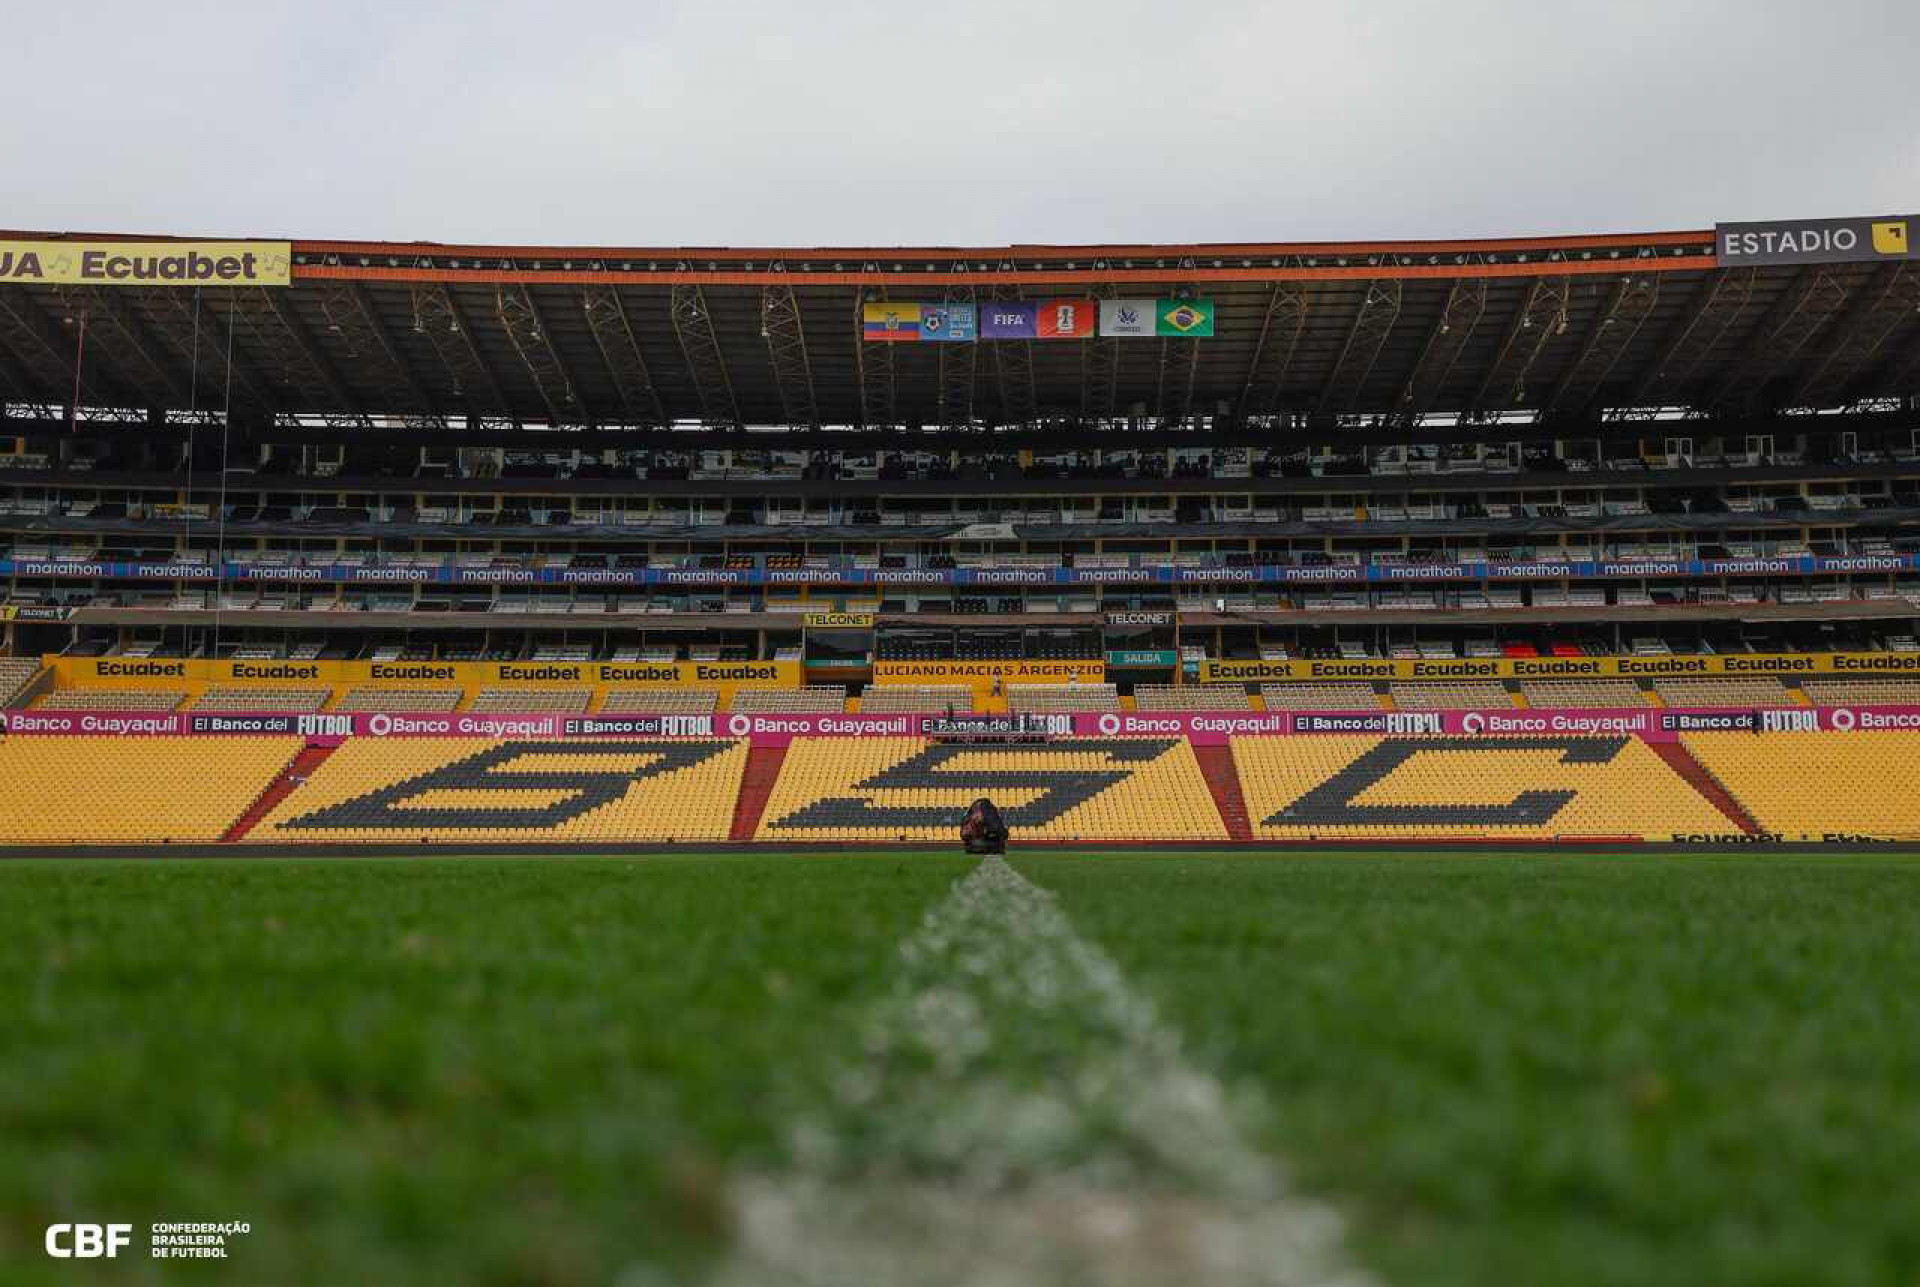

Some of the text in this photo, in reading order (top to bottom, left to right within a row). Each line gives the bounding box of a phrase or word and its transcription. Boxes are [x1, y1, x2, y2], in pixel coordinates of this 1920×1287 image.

[1725, 228, 1858, 255] ESTADIO
[81, 252, 257, 279] Ecuabet
[994, 314, 1023, 325] FIFA
[26, 562, 102, 575] marathon
[139, 563, 213, 577] marathon
[1497, 563, 1570, 577] marathon
[1604, 561, 1678, 575] marathon
[1714, 559, 1788, 573] marathon
[1824, 556, 1901, 570] marathon
[249, 565, 322, 579] marathon
[357, 566, 428, 580] marathon
[463, 567, 533, 581] marathon
[564, 568, 634, 582] marathon
[668, 569, 737, 583] marathon
[771, 569, 841, 583] marathon
[874, 569, 943, 582] marathon
[977, 568, 1046, 582] marathon
[1079, 568, 1149, 582] marathon
[1182, 567, 1252, 581] marathon
[1286, 566, 1356, 580] marathon
[1391, 565, 1462, 578] marathon
[808, 614, 872, 625] TELCONET
[1109, 613, 1170, 624] TELCONET
[96, 661, 186, 677] Ecuabet
[875, 665, 946, 676] LUCIANO
[1018, 665, 1103, 676] ARGENZIO
[1209, 664, 1292, 677] Ecuabet
[1312, 663, 1395, 677] Ecuabet
[1414, 662, 1498, 676] Ecuabet
[1514, 660, 1600, 674] Ecuabet
[1618, 659, 1706, 673] Ecuabet
[1724, 657, 1814, 671] Ecuabet
[232, 664, 318, 679] Ecuabet
[371, 665, 455, 680] Ecuabet
[500, 665, 580, 681] Ecuabet
[601, 666, 680, 681] Ecuabet
[697, 665, 778, 680] Ecuabet
[12, 715, 178, 734] Banco Guayaquil
[194, 717, 208, 730] El
[212, 717, 261, 730] Banco
[264, 717, 287, 730] del
[566, 720, 578, 733] El
[584, 720, 633, 733] Banco
[635, 720, 658, 732] del
[1126, 716, 1279, 734] Banco Guayaquil
[1297, 717, 1308, 730] El
[1314, 717, 1361, 730] Banco
[1364, 716, 1385, 730] del
[1490, 715, 1645, 733] Banco Guayaquil
[1662, 716, 1675, 729] El
[1680, 716, 1729, 729] Banco
[1736, 714, 1753, 727] de
[1861, 712, 1920, 727] Banco
[395, 718, 553, 737] Banco Guayaquil
[755, 718, 906, 736] Banco Guayaquil
